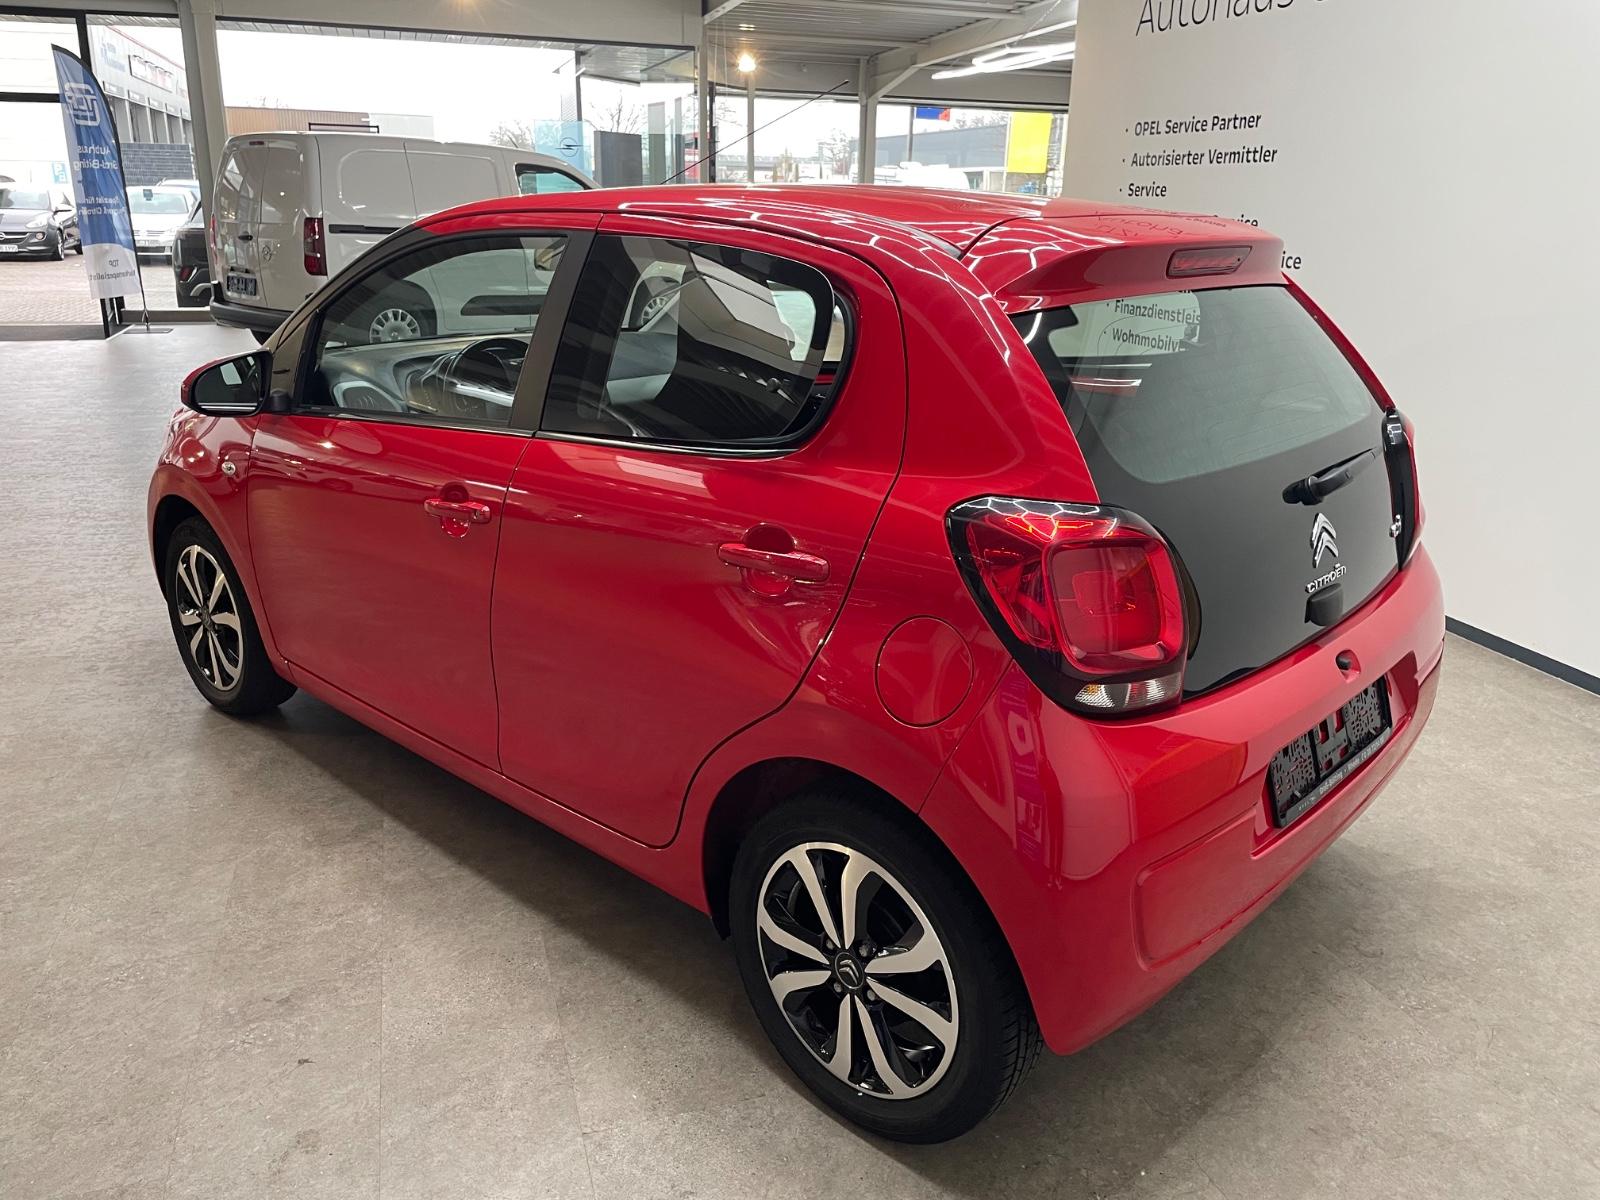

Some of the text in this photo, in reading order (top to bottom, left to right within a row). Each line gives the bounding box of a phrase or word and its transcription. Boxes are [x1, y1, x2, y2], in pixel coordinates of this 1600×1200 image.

[1136, 0, 1293, 36] Autoa
[1134, 113, 1262, 136] OPEL Service Partner
[1131, 145, 1278, 167] Autorisierter Vermittler
[1127, 181, 1167, 197] Service
